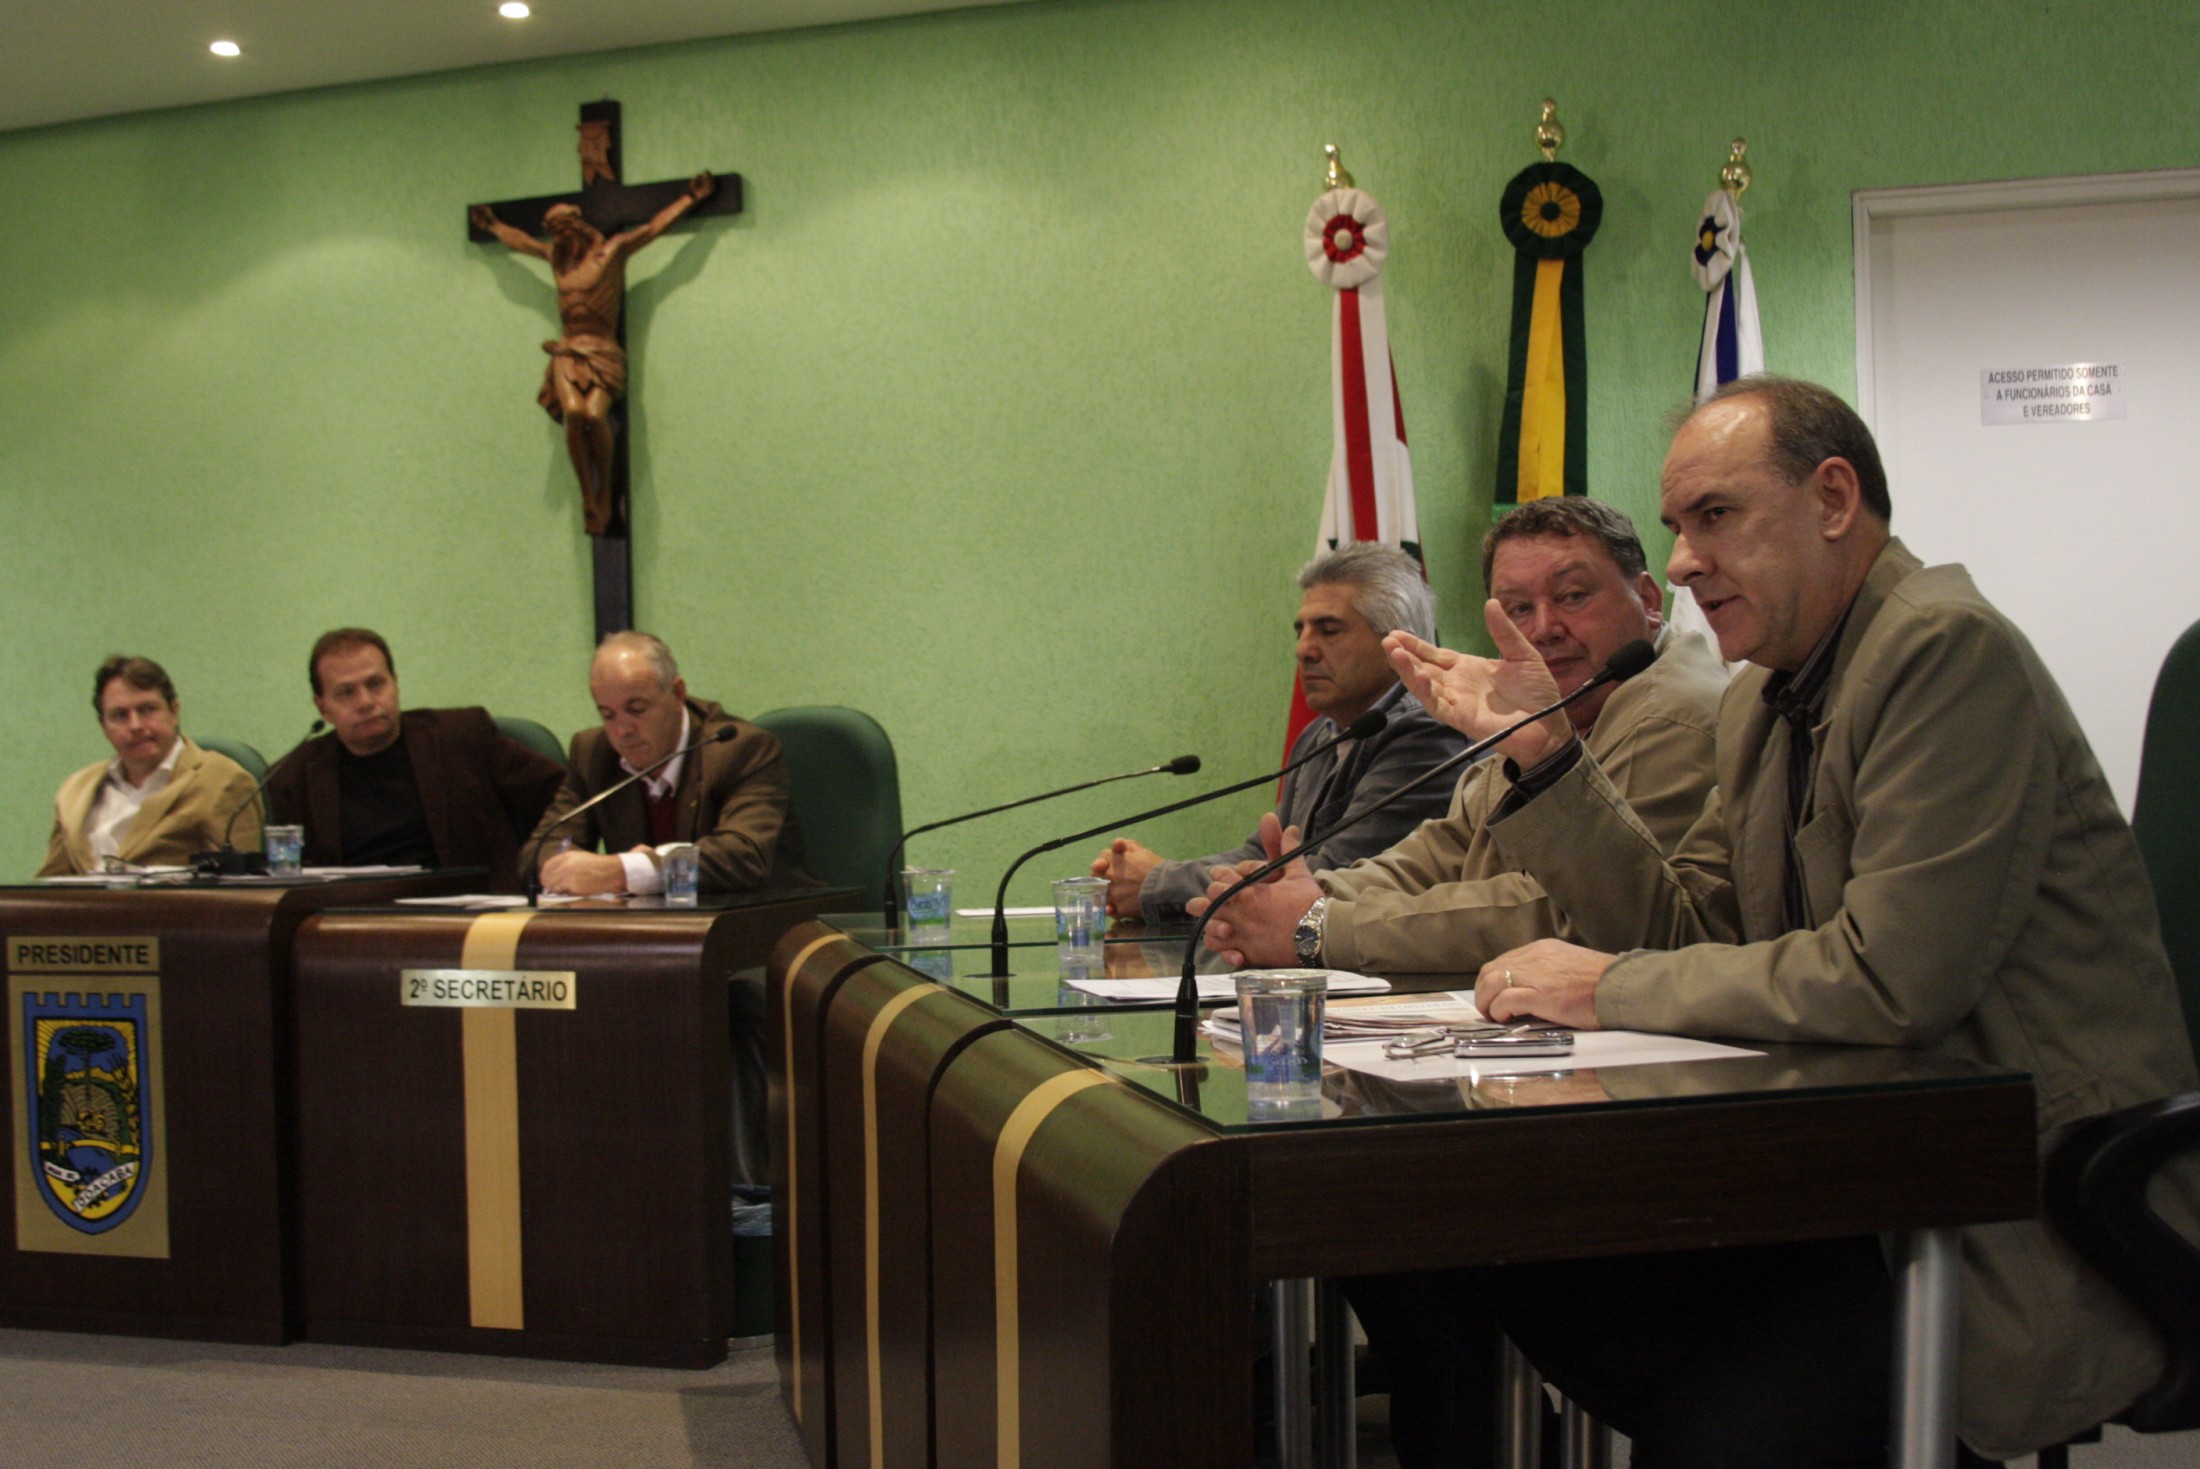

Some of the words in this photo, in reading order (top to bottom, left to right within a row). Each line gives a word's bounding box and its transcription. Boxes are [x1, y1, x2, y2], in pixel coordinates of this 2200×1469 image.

[1988, 371, 2025, 384] ACESSO
[2026, 368, 2074, 382] PERMITIDO
[2076, 365, 2118, 379] SOMENTE
[1996, 389, 2003, 401] A
[2004, 383, 2071, 401] FUNCIONÁRIOS
[2072, 385, 2085, 397] DA
[2087, 383, 2112, 396] CASA
[2023, 405, 2029, 417] E
[2031, 402, 2091, 417] VEREADORES
[17, 944, 149, 965] PRESIDENTE
[433, 976, 568, 1001] SECRETÁRIO
